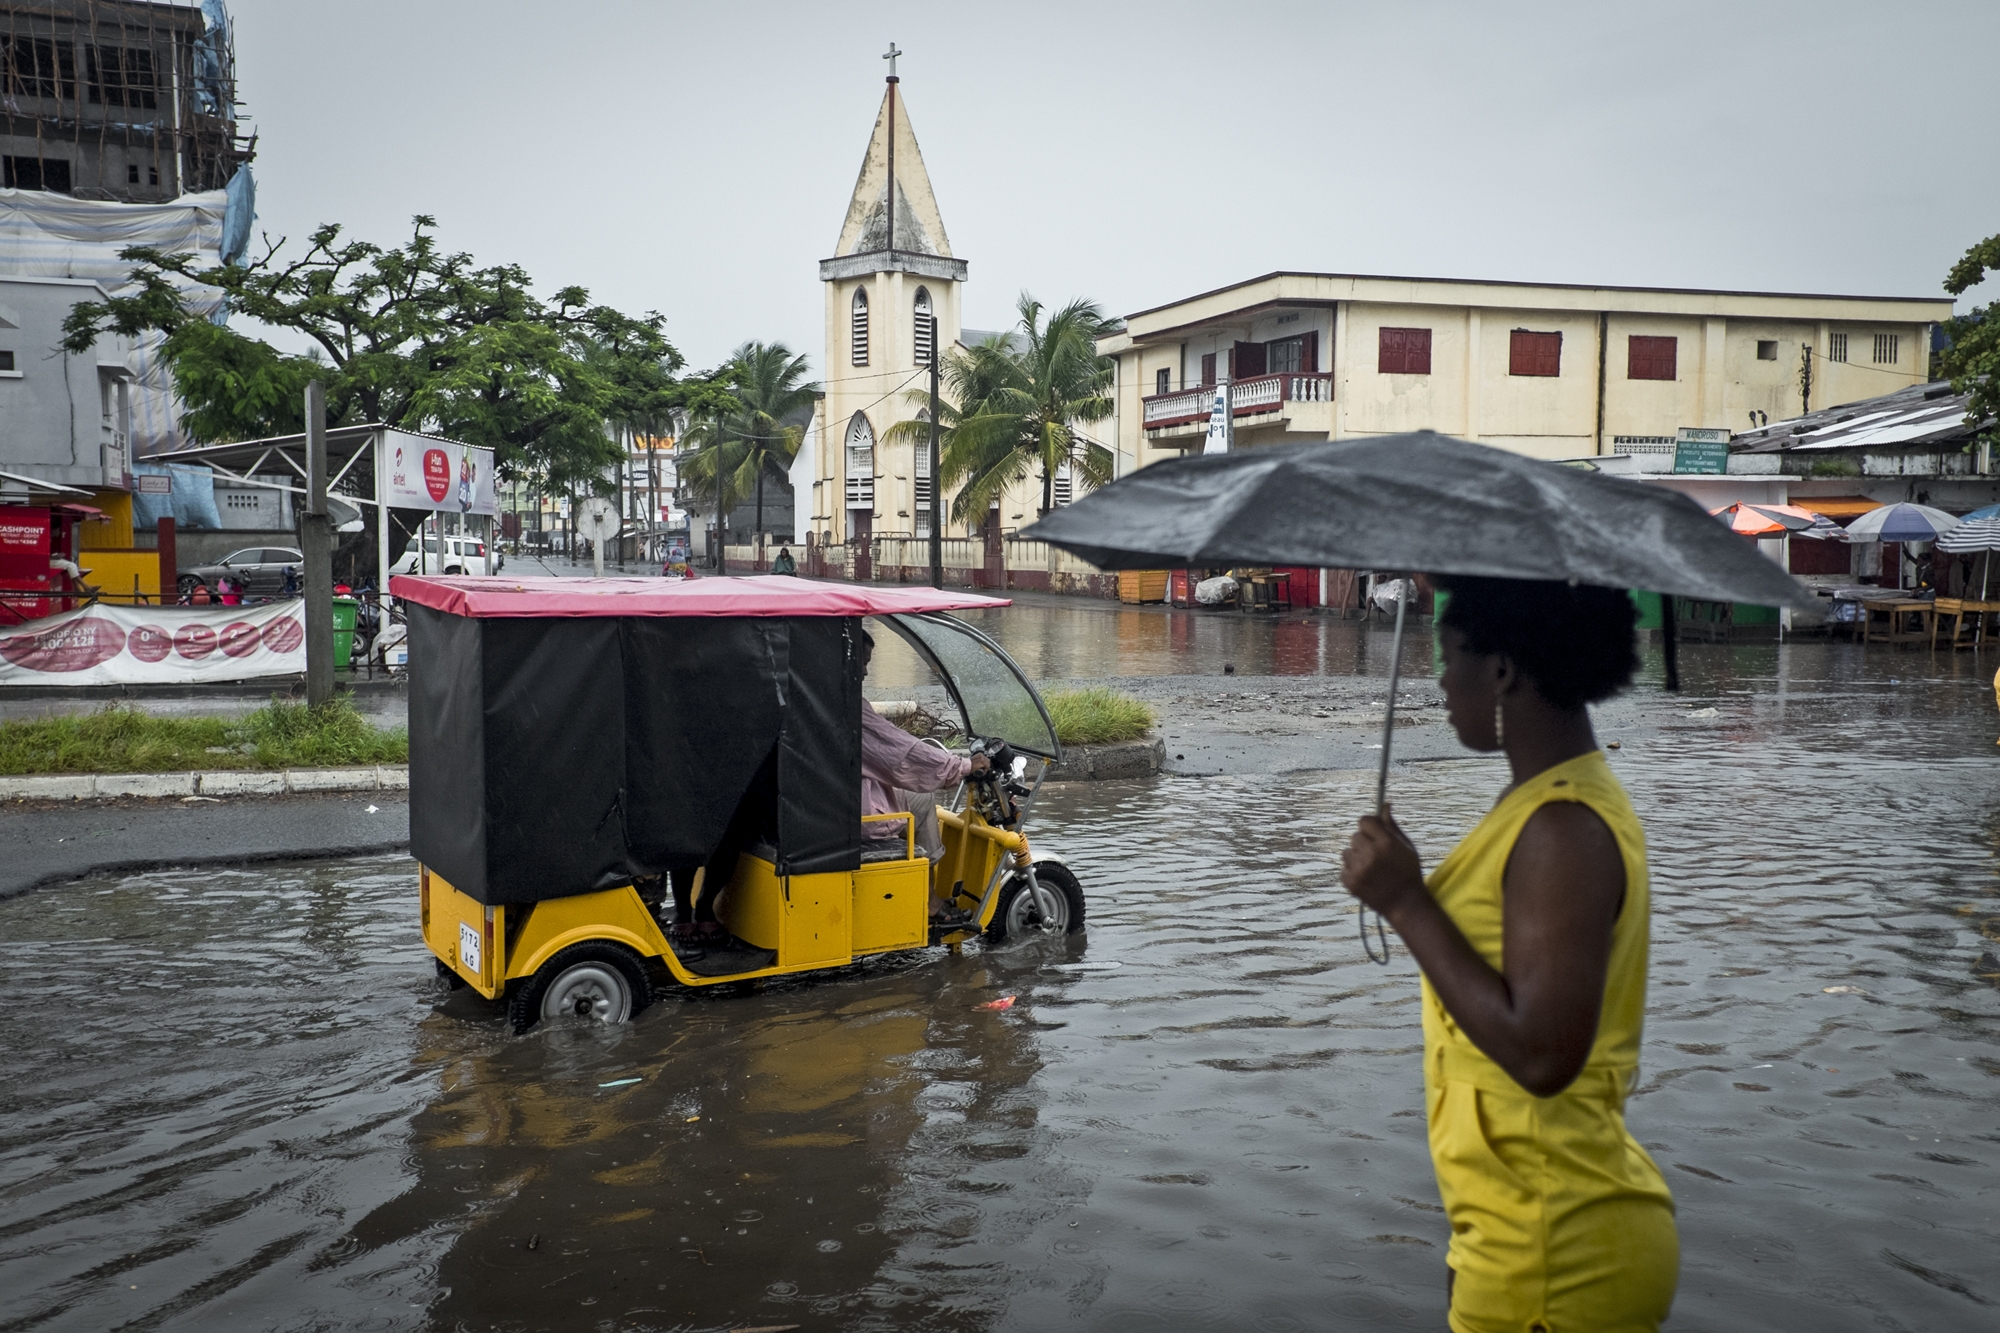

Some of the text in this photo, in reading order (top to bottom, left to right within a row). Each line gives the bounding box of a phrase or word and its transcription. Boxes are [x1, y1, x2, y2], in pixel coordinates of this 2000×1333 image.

[393, 472, 406, 486] airtel
[83, 626, 97, 635] NY
[188, 631, 195, 642] 1
[465, 952, 474, 967] AG
